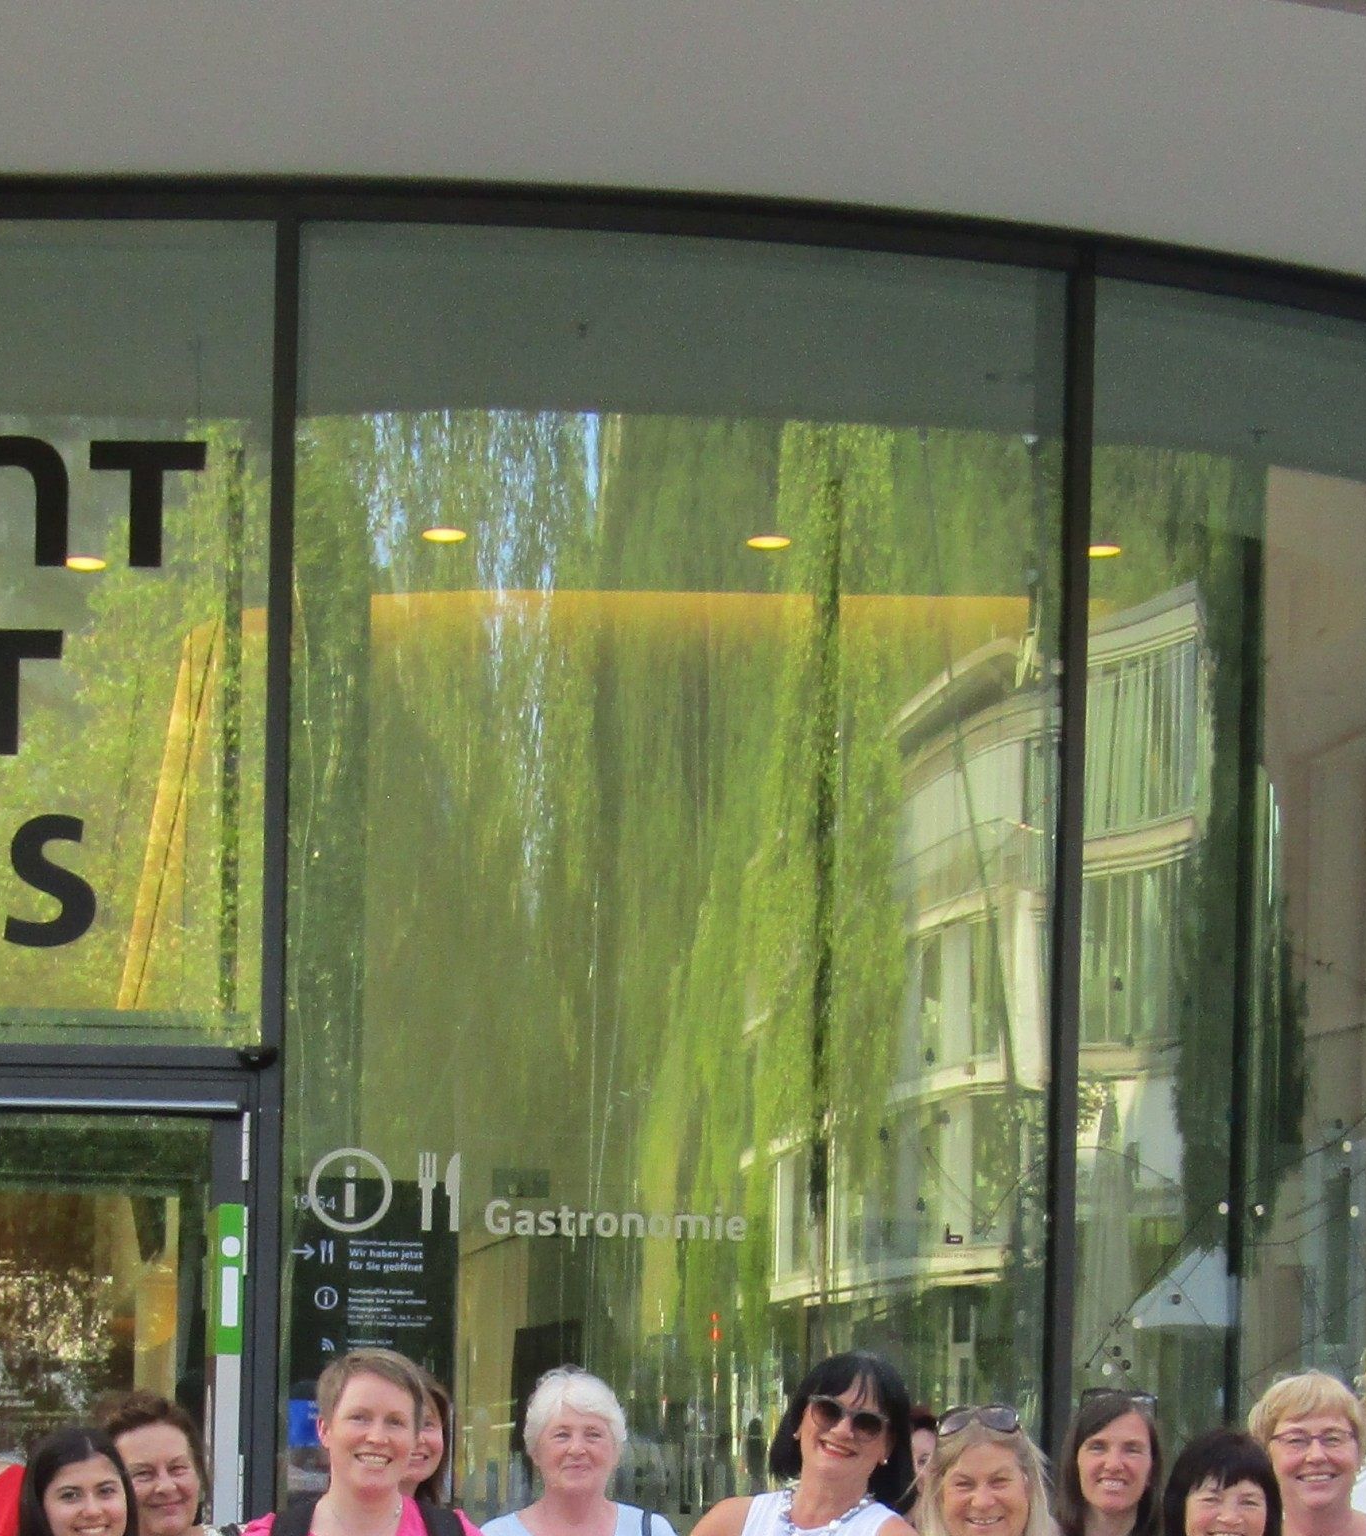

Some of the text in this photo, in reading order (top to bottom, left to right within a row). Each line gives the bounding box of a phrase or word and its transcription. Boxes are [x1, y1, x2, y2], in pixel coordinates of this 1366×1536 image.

[485, 1200, 748, 1241] Gastronomie
[349, 1247, 423, 1260] Wir haben jetzt
[348, 1260, 423, 1273] für Sie geöffnet
